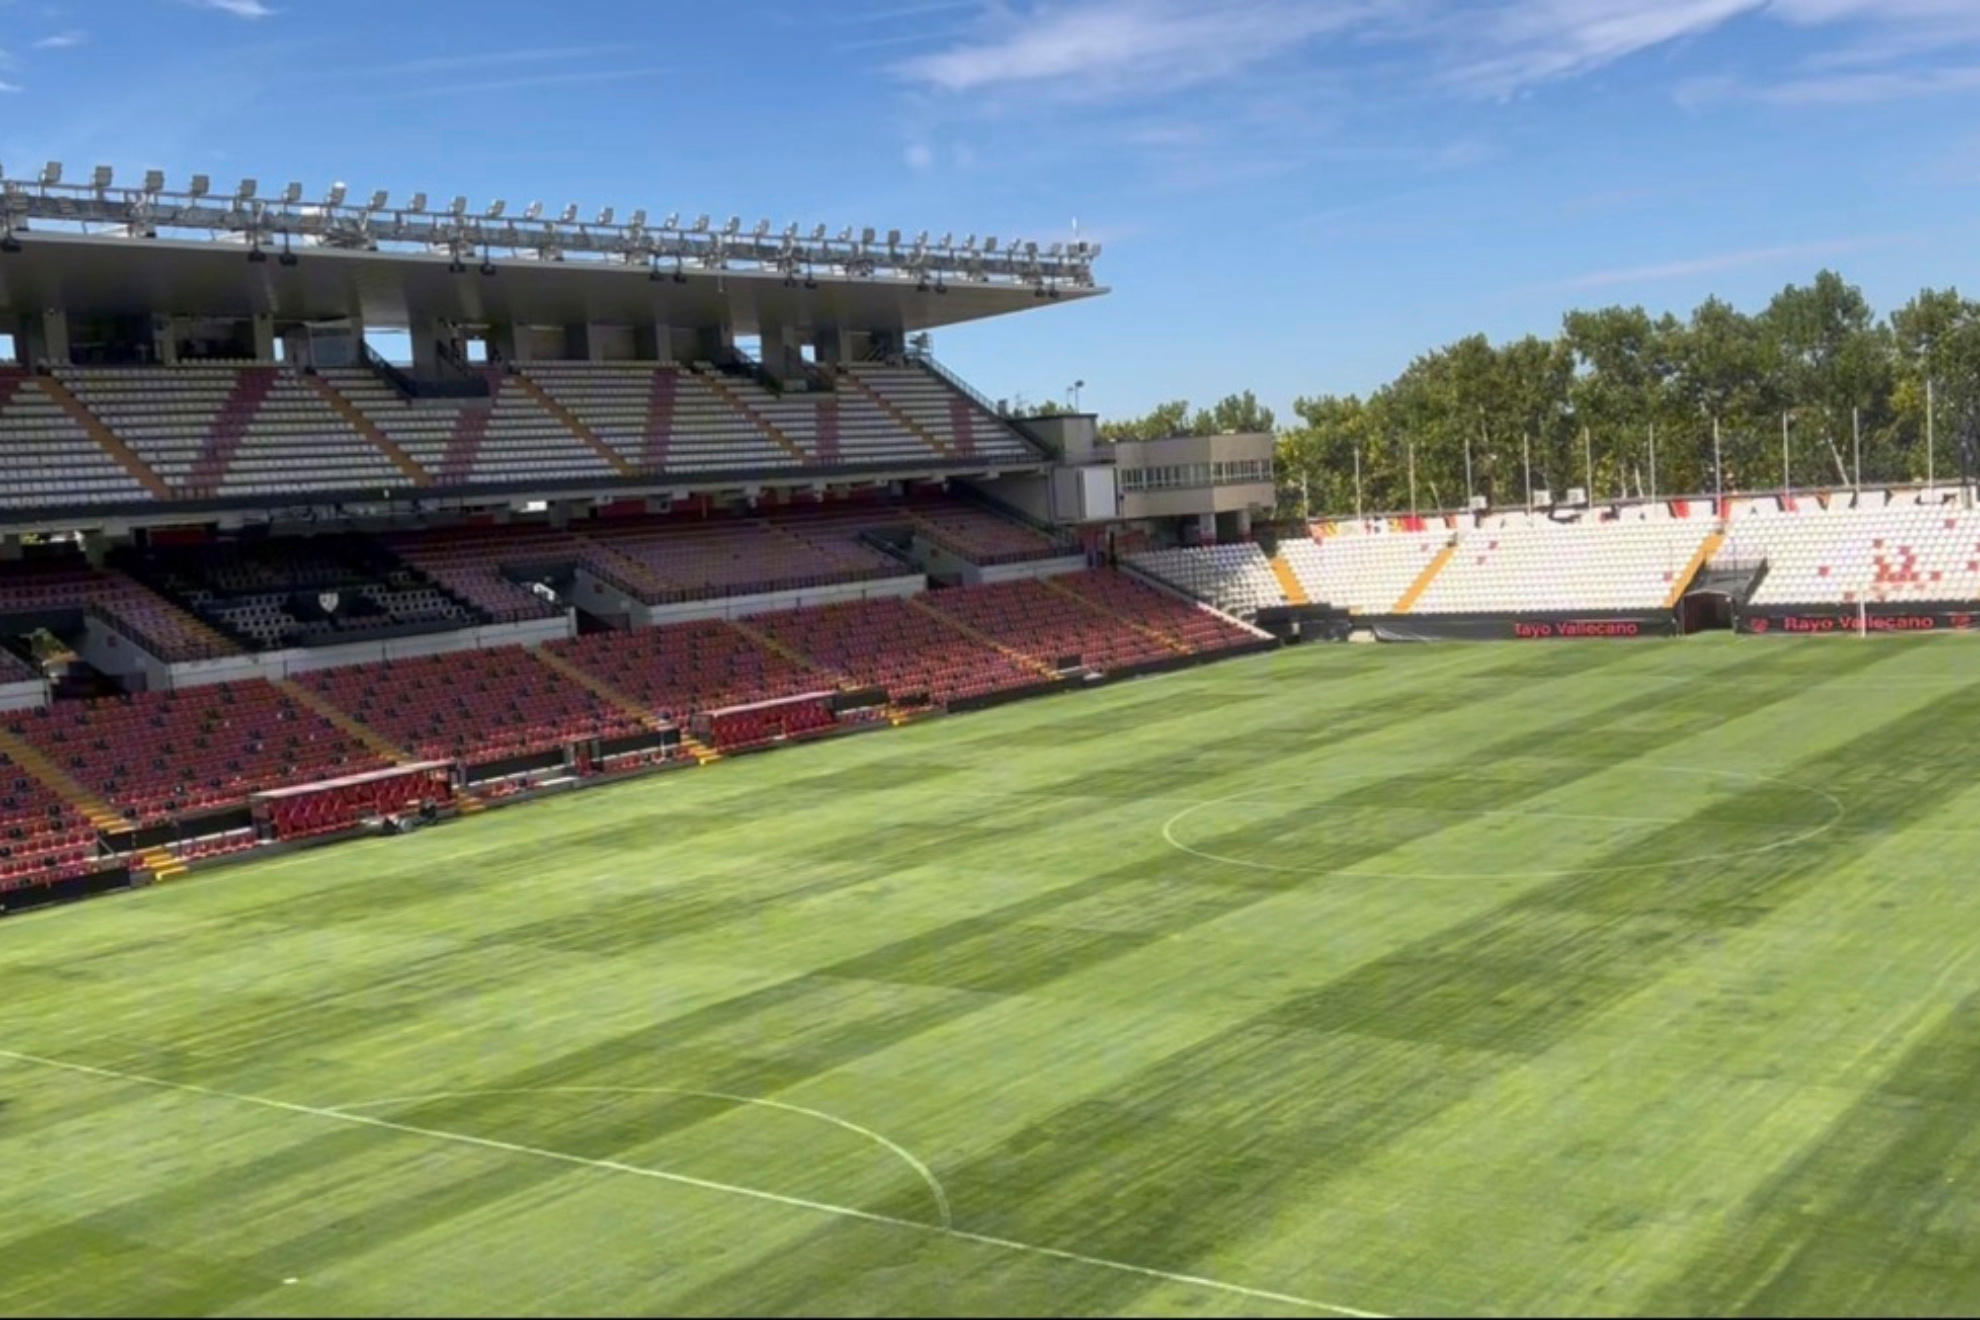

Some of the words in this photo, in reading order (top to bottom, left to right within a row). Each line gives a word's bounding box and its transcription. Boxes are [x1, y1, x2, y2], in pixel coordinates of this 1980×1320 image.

[1556, 621, 1638, 635] Vallecano
[1784, 616, 1833, 633] Rayo
[1838, 615, 1934, 629] Valecano
